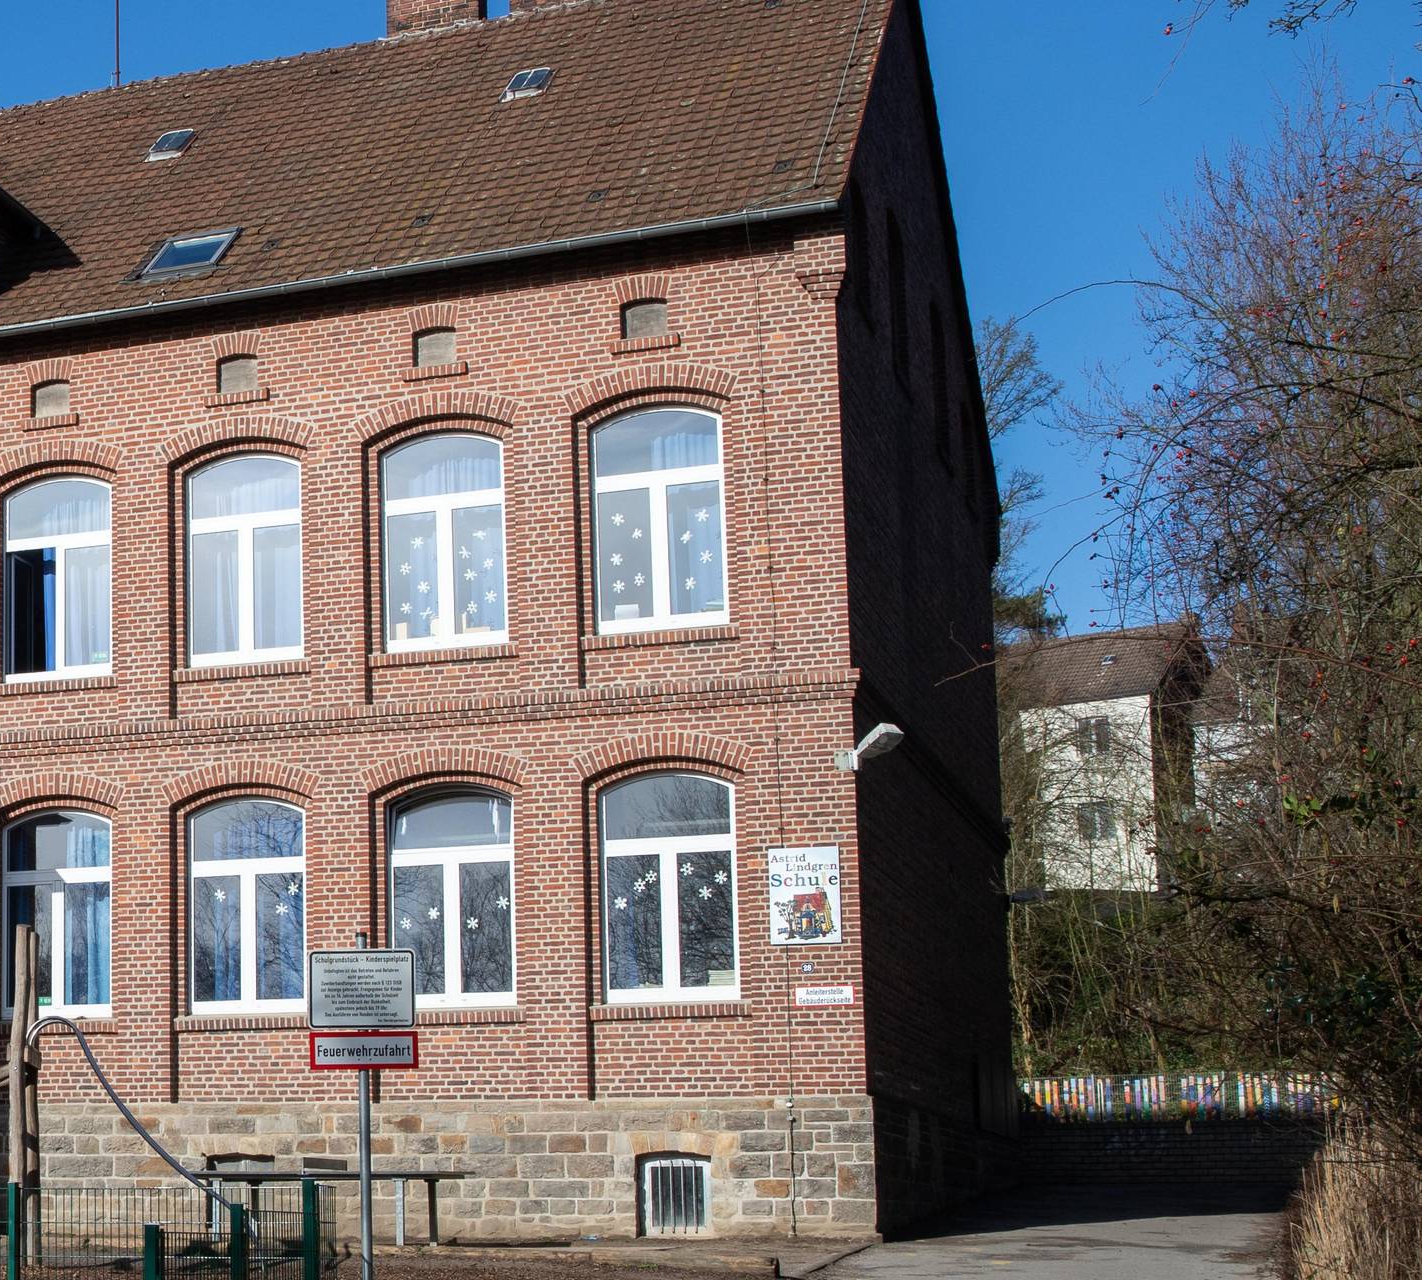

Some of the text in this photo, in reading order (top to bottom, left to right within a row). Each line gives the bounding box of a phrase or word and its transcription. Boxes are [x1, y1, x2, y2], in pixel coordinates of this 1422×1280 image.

[771, 854, 806, 863] Astrid
[786, 863, 837, 872] Lindgren
[771, 872, 838, 887] Schule
[317, 1045, 410, 1057] Feuerwehrzufahrt
